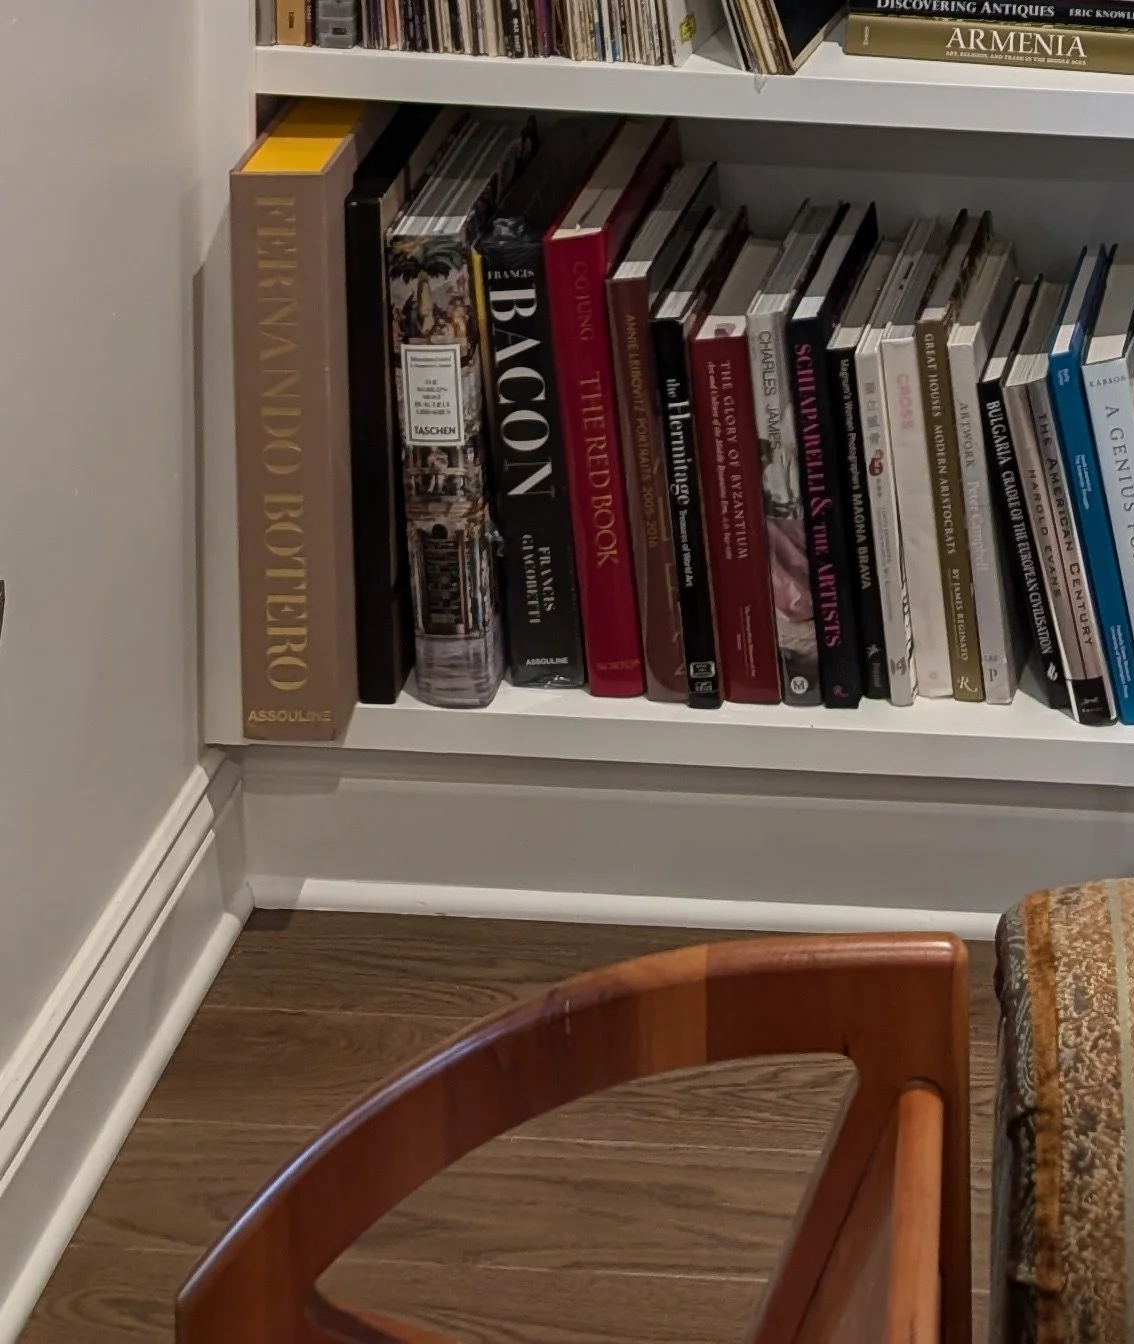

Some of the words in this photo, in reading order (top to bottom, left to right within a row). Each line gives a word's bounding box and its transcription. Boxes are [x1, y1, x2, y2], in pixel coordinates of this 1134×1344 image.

[946, 27, 1088, 58] ARMENIA
[981, 2, 1055, 17] ANTIQUES
[255, 196, 305, 474] FERNANDO
[489, 288, 556, 499] BACON
[578, 371, 605, 427] THE
[1104, 404, 1121, 416] A
[584, 427, 611, 488] RED
[667, 400, 694, 506] Hermitage
[589, 493, 618, 570] BOOK
[263, 492, 309, 692] BOTERO
